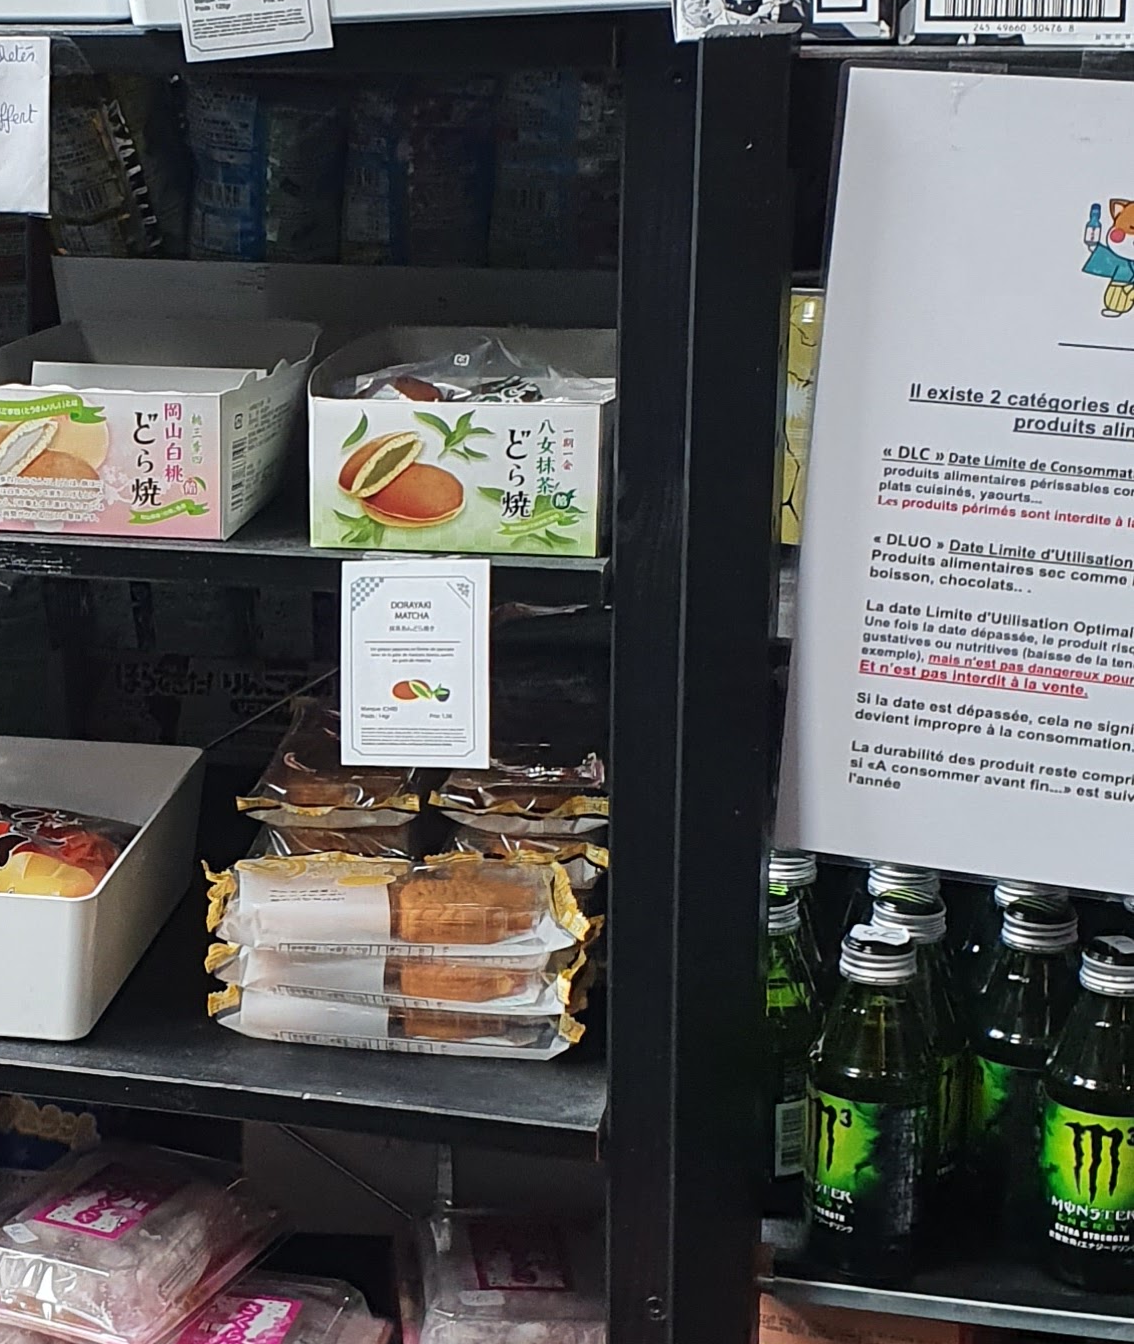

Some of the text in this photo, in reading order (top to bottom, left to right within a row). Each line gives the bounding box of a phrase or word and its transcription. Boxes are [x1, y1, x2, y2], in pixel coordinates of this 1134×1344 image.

[973, 24, 1075, 32] 245 49660 50476 8
[927, 385, 1110, 414] existe catégories
[1013, 416, 1096, 434] produits
[164, 402, 183, 483] 岡山白桃
[536, 418, 558, 495] 八女抹茶
[131, 410, 162, 507] どら焼
[898, 446, 1026, 470] DLC Date Limite
[500, 428, 532, 519] どら焼
[879, 481, 912, 492] plats
[883, 465, 1110, 497] produits alimentaires périssables
[902, 496, 1111, 526] produits périmés interdite
[886, 533, 1133, 569] DLUO Date Limite d'Utilisation
[870, 566, 935, 585] boisson,
[871, 549, 1128, 586] Produits alimentaires comme
[390, 601, 431, 609] DORAYAKI
[394, 612, 429, 620] MATCHA
[889, 602, 1069, 632] date Limite d'Utilisation
[862, 631, 1019, 657] gustatives nutritives
[971, 626, 1107, 654] dépassée, produit
[861, 646, 1100, 682] exemple), dangereux
[952, 667, 1006, 687] interdit
[854, 709, 982, 735] devient impropre
[893, 696, 1034, 725] date dépassée,
[874, 743, 1077, 778] durabilité produit reste
[891, 764, 1026, 789] consommer avant
[1054, 1222, 1080, 1238] EXTRA
